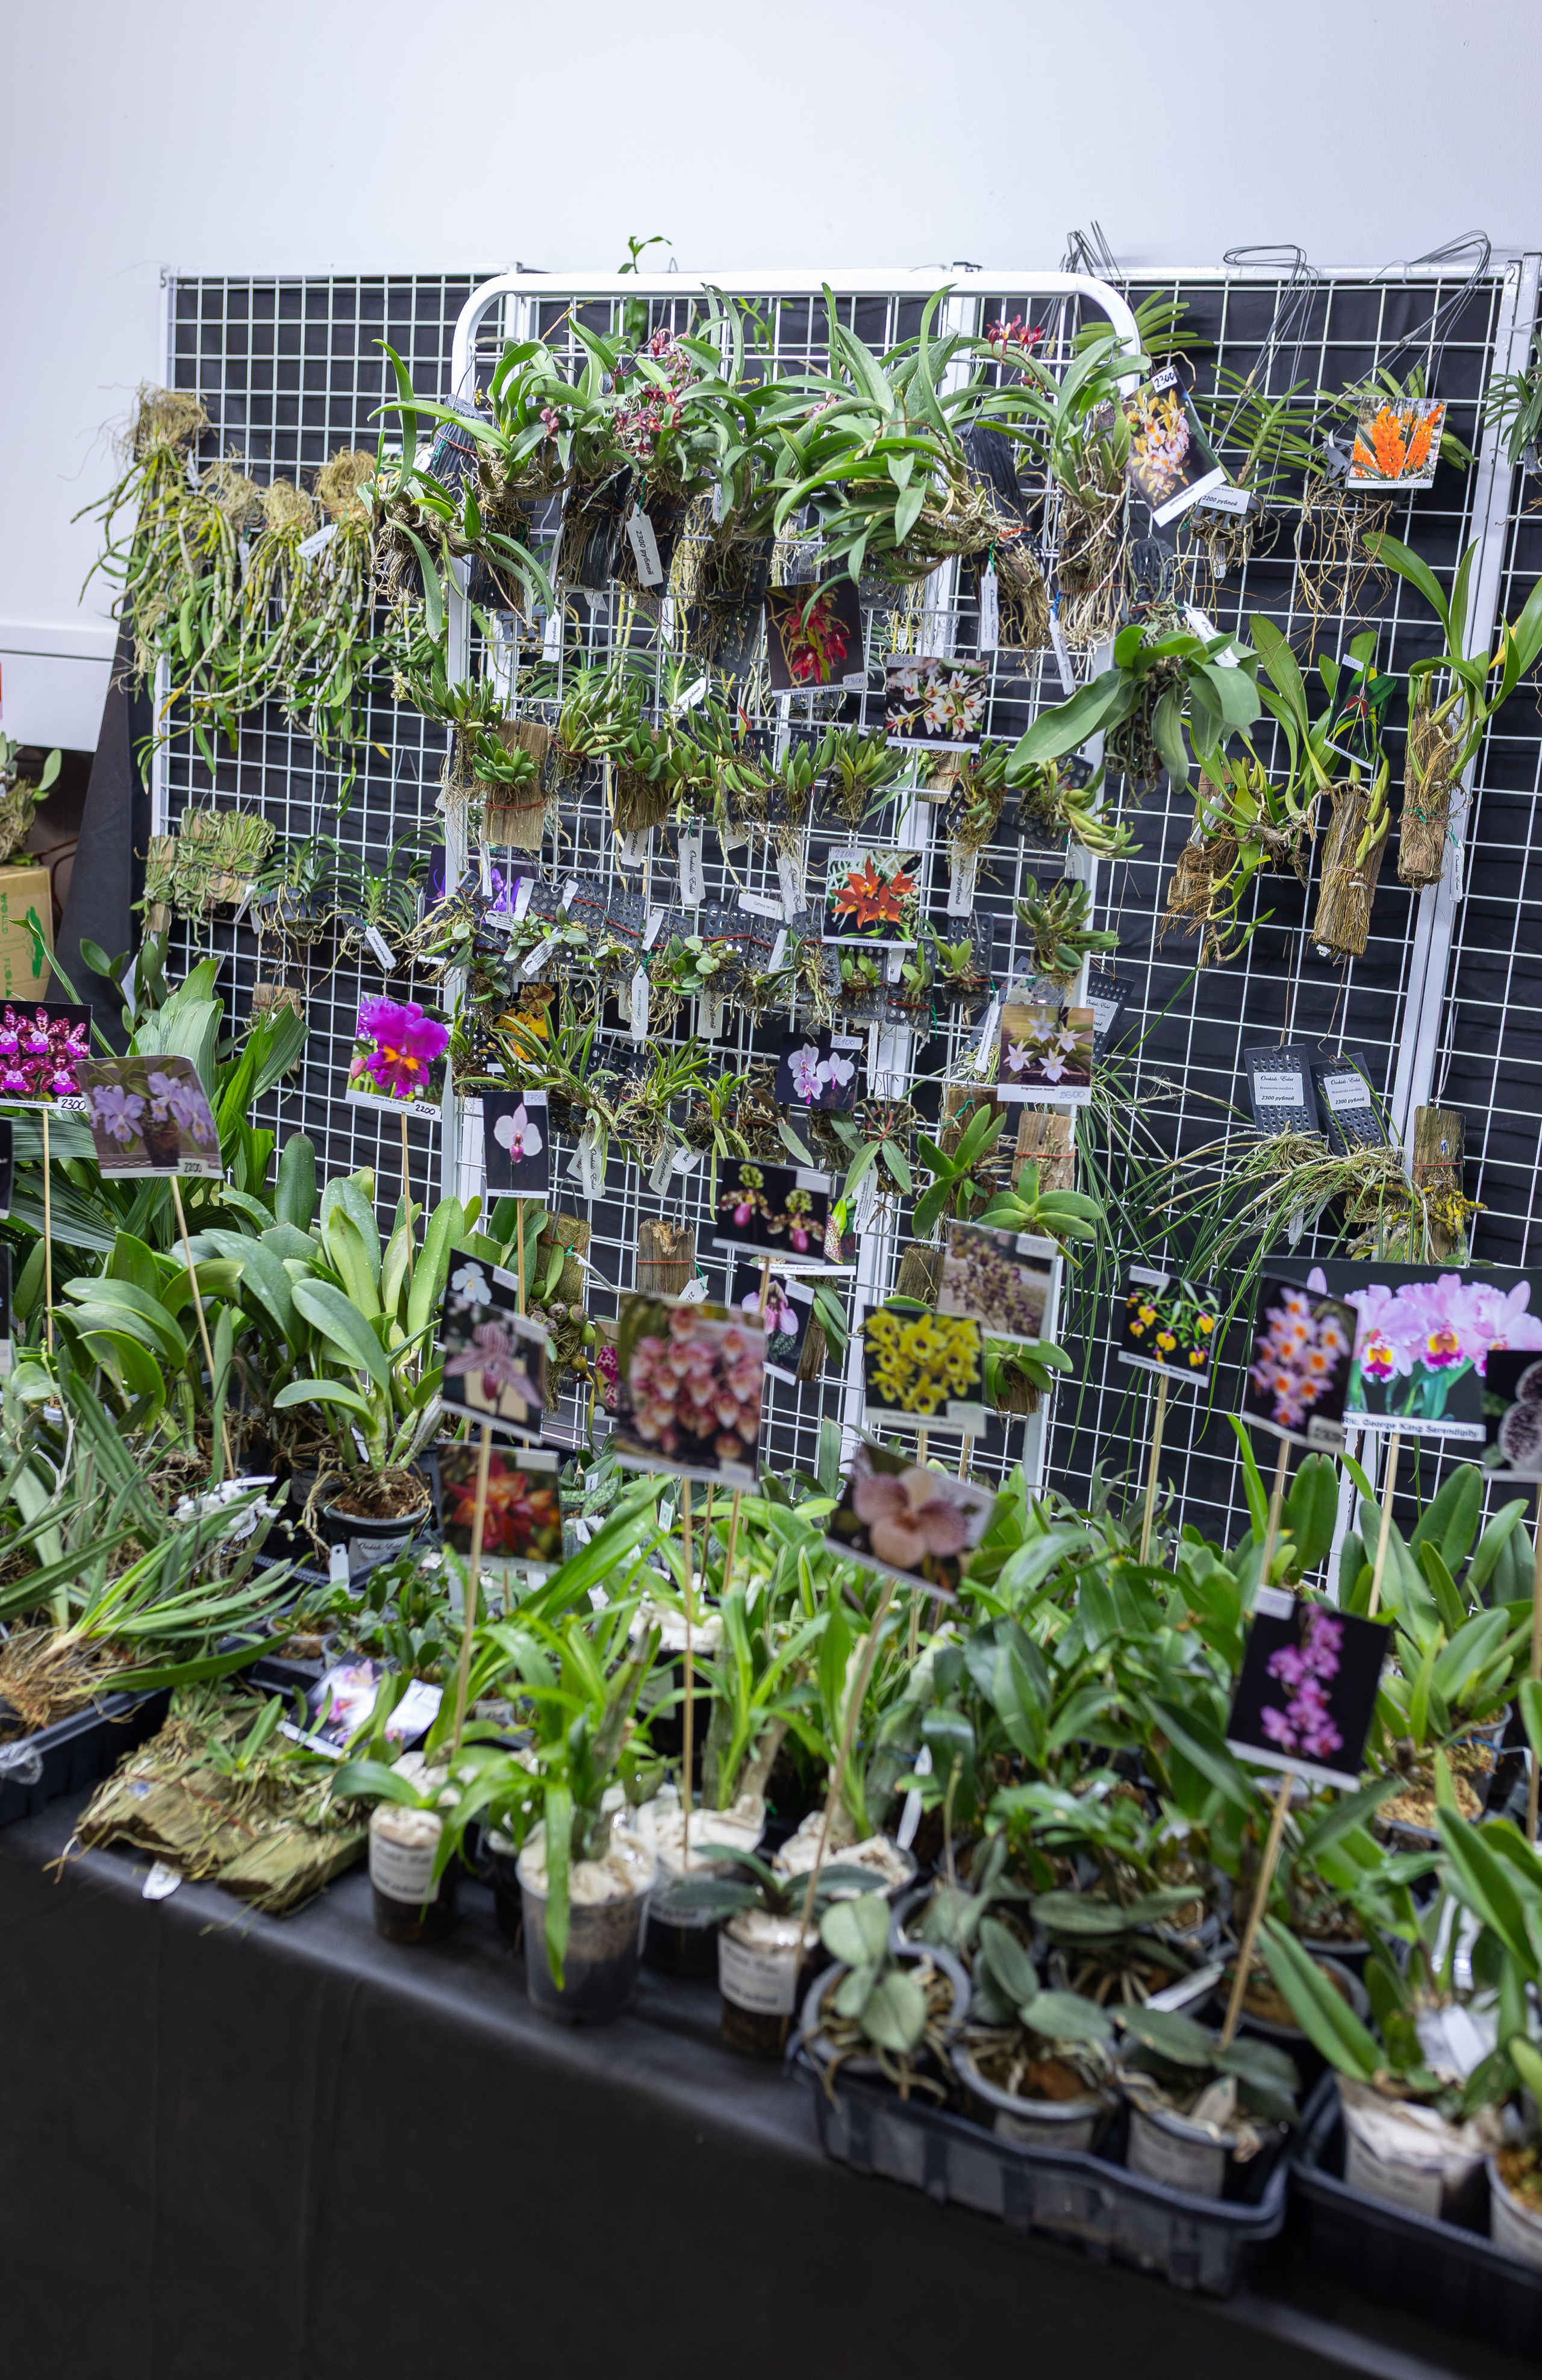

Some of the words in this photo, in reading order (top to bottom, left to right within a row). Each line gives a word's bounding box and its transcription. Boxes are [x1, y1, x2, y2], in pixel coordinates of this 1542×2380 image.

[1154, 372, 1176, 388] 2300
[1217, 498, 1238, 507] рублей
[635, 530, 646, 548] 2300
[640, 549, 655, 575] рублей
[890, 655, 914, 665] 2300
[844, 676, 864, 687] 2300
[835, 849, 855, 859] 2200
[955, 878, 963, 905] рублей
[61, 1098, 86, 1111] 2300
[415, 1104, 435, 1115] 2200
[658, 1164, 667, 1186] рублей
[1362, 1419, 1396, 1430] George
[1399, 1422, 1423, 1433] King
